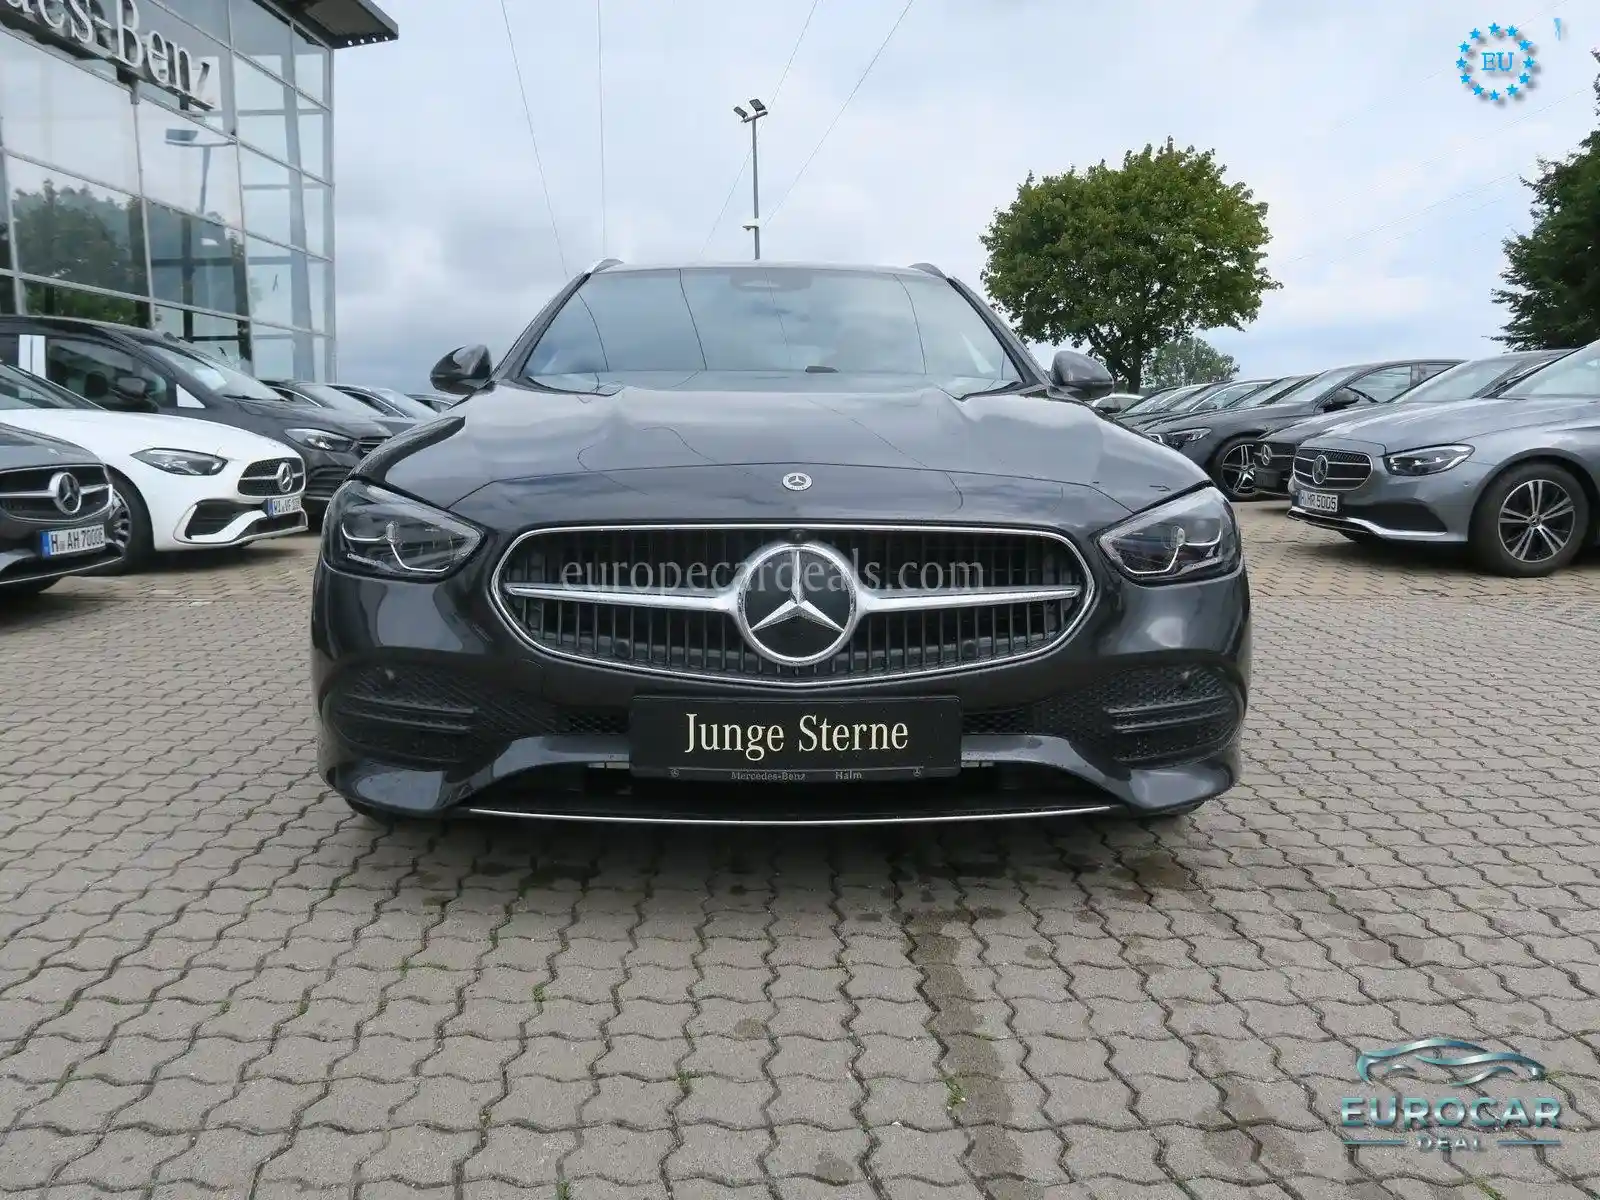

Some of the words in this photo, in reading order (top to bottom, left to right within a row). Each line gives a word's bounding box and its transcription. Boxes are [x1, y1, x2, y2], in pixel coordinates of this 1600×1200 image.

[50, 533, 59, 553] H
[684, 713, 785, 761] Junge
[798, 714, 909, 752] Sterne
[731, 771, 806, 781] Mercedes-Benz
[835, 769, 863, 780] Halm
